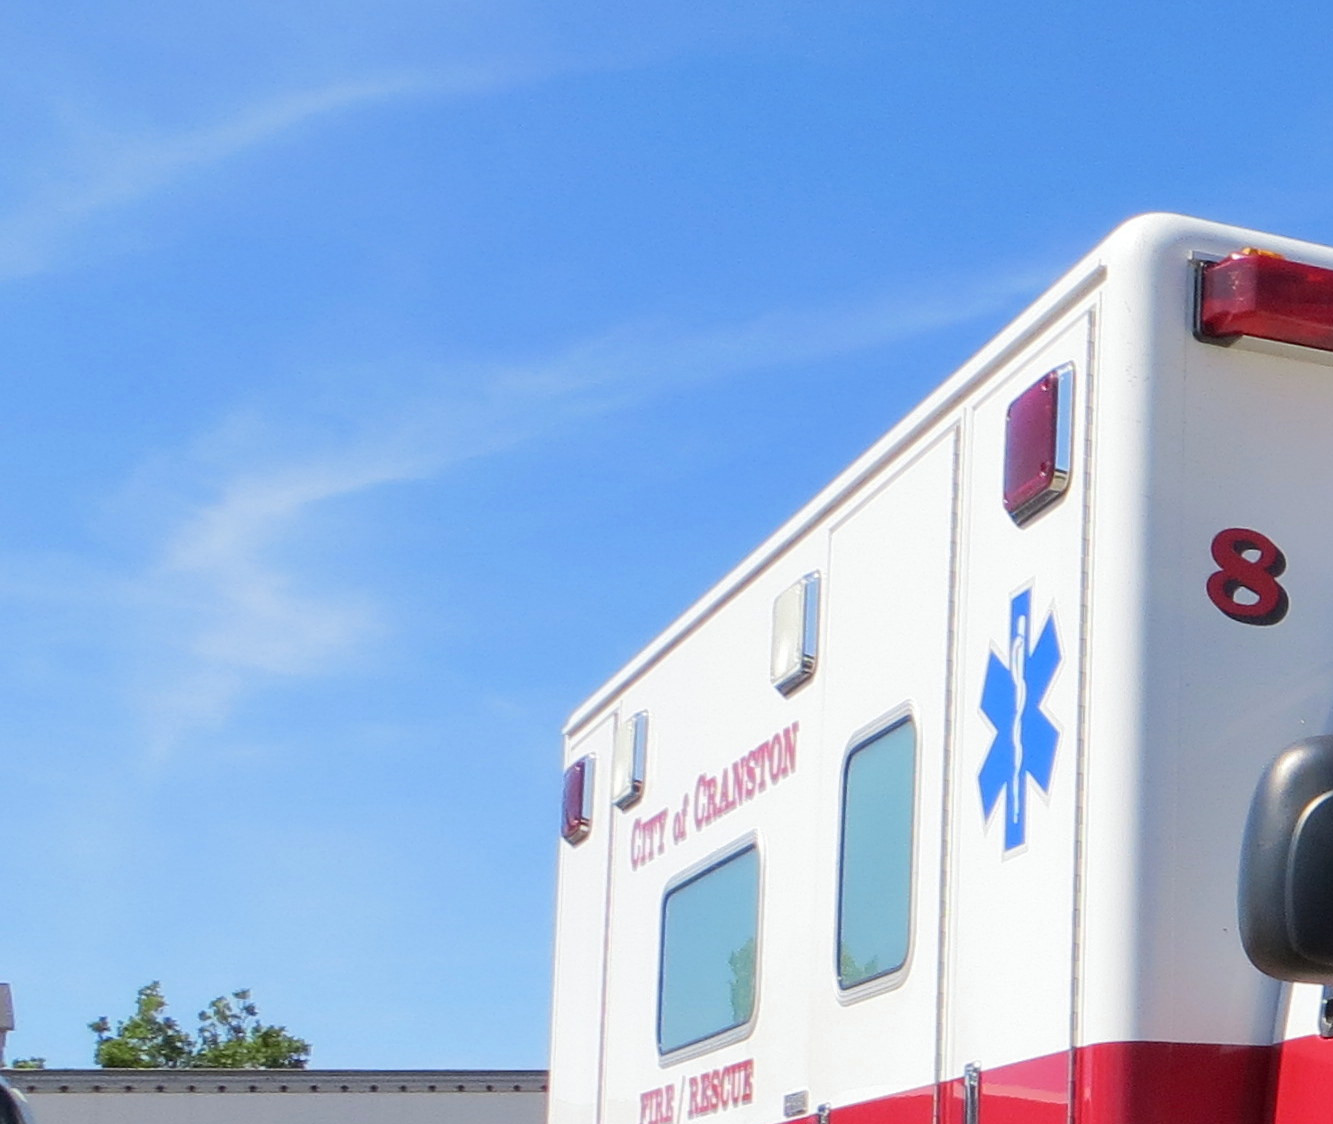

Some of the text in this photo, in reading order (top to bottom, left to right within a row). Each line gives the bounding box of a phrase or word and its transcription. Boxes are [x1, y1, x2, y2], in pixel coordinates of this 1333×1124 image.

[1206, 528, 1289, 626] 8
[631, 720, 800, 872] CITY of CRANSTON
[688, 1058, 755, 1120] RESCUE
